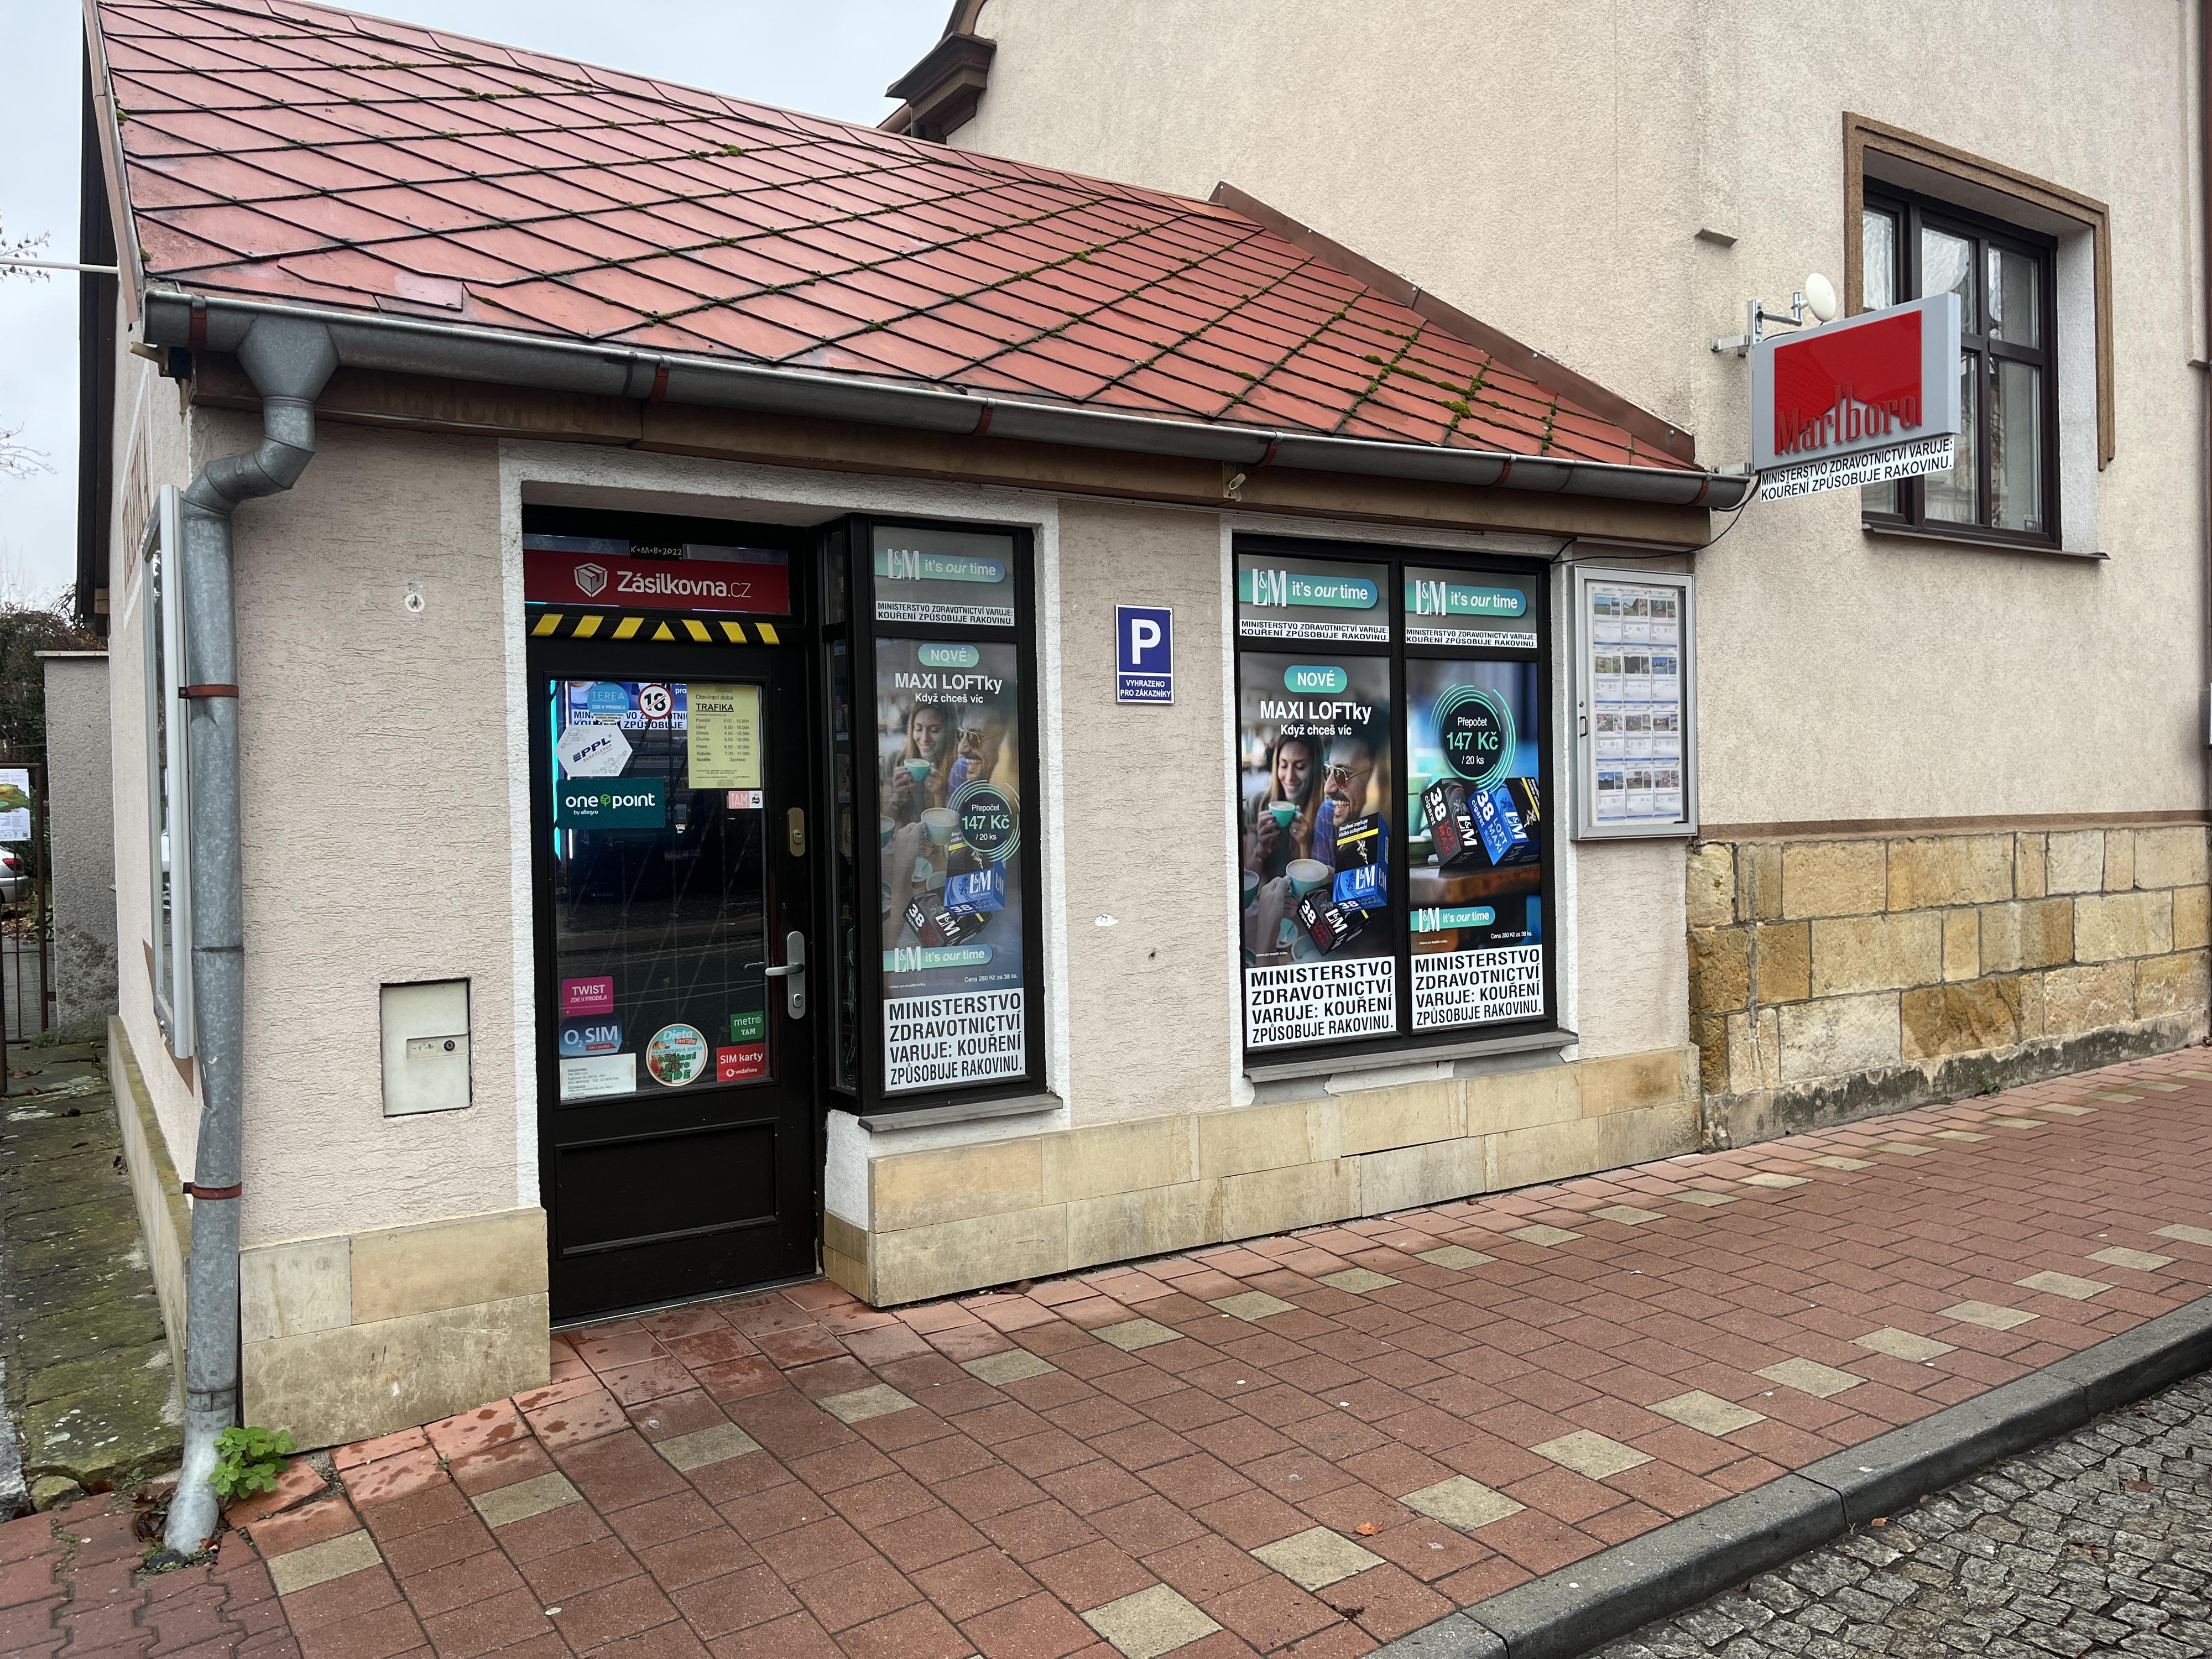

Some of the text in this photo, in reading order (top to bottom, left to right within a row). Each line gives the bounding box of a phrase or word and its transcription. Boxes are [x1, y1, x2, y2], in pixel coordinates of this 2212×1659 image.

[1775, 381, 1917, 456] Marlboro
[1762, 439, 1952, 486] MINISTERSTVO ZDRAVOTNICTVÍ VARUJE:
[1761, 456, 1952, 501] KOUŘENÍ ZPŮSOBUJE RAKOVINU.
[631, 546, 682, 556] K+M+B+2022
[888, 549, 995, 580] L&M it's our time
[1252, 568, 1368, 607] L&M it's our time
[1416, 580, 1517, 616] L&M it's our time
[878, 603, 930, 612] MINISTERSTVO
[932, 606, 984, 614] ZDRAVOTNICTVÍ
[878, 612, 1013, 624] KOUŘENÍ ZPŮSOBUJE RAKOVINU.
[1242, 621, 1298, 629] MINISTERSTVO
[1301, 624, 1357, 632] ZDRAVOTNICTVÍ
[1286, 629, 1338, 639] ZPŮSOBUJE
[1131, 619, 1161, 664] P
[1446, 637, 1491, 645] ZPŮSOBUJE
[931, 648, 967, 661] NOVÉ
[895, 672, 1002, 693] MAXI LOFTky
[1297, 670, 1335, 686] NOVÉ
[592, 692, 625, 700] TEREA
[644, 693, 665, 711] 18
[915, 693, 938, 704] Když
[941, 694, 968, 702] chceš
[1135, 688, 1171, 697] ZÁKAZNÍKY
[1260, 701, 1371, 724] MAXI LOFTky
[1458, 717, 1487, 727] Přepočet
[1281, 724, 1352, 737] Když chceš víc
[1447, 732, 1499, 750] 147 Kč
[583, 744, 612, 762] PARCELSHOP
[1466, 755, 1484, 764] 20 ks
[566, 793, 655, 808] one point
[731, 793, 748, 806] TAM
[972, 804, 999, 812] Přepočet
[1425, 795, 1436, 826] cigaret
[1431, 787, 1446, 822] 38
[1477, 790, 1494, 821] 38
[962, 815, 1009, 830] 147 Kč
[1472, 800, 1485, 827] cigaret
[1505, 812, 1527, 839] L&M
[1457, 816, 1478, 846] L&M
[1488, 823, 1503, 853] MAXI
[1494, 817, 1508, 844] LOFT
[969, 870, 991, 894] L&M
[1355, 865, 1375, 889] L&M
[909, 904, 925, 927] 38
[951, 904, 973, 912] 38
[1302, 900, 1316, 924] 38
[1339, 900, 1359, 909] 38
[935, 912, 961, 936] L&M
[1325, 908, 1348, 933] L&M
[1418, 907, 1489, 932] L&M it's our time
[895, 946, 985, 973] L&M it's our time
[1416, 948, 1540, 973] MINISTERSTVO
[1251, 961, 1392, 987] MINISTERSTVO
[1416, 963, 1540, 990] ZDRAVOTNICTVÍ
[572, 985, 605, 995] TWIST
[1252, 975, 1391, 1006] ZDRAVOTNICTVÍ
[1416, 979, 1540, 1008] VARUJE: KOUŘENÍ
[889, 993, 1020, 1020] MINISTERSTVO
[1252, 994, 1391, 1024] VARUJE: KOUŘENÍ
[1416, 999, 1541, 1026] ZPŮSOBUJE RAKOVINU.
[734, 1016, 761, 1026] metro
[890, 1010, 1021, 1042] ZDRAVOTNICTVÍ
[1253, 1015, 1393, 1044] ZPŮSOBUJE RAKOVINU.
[585, 1025, 618, 1043] SIM
[663, 1030, 693, 1040] Dieta
[720, 1052, 763, 1063] SIM karty
[890, 1031, 1021, 1063] VARUJE: KOUŘENÍ
[665, 1070, 691, 1080] ZDE
[890, 1055, 1022, 1085] ZPŮSOBUJE RAKOVINU.
